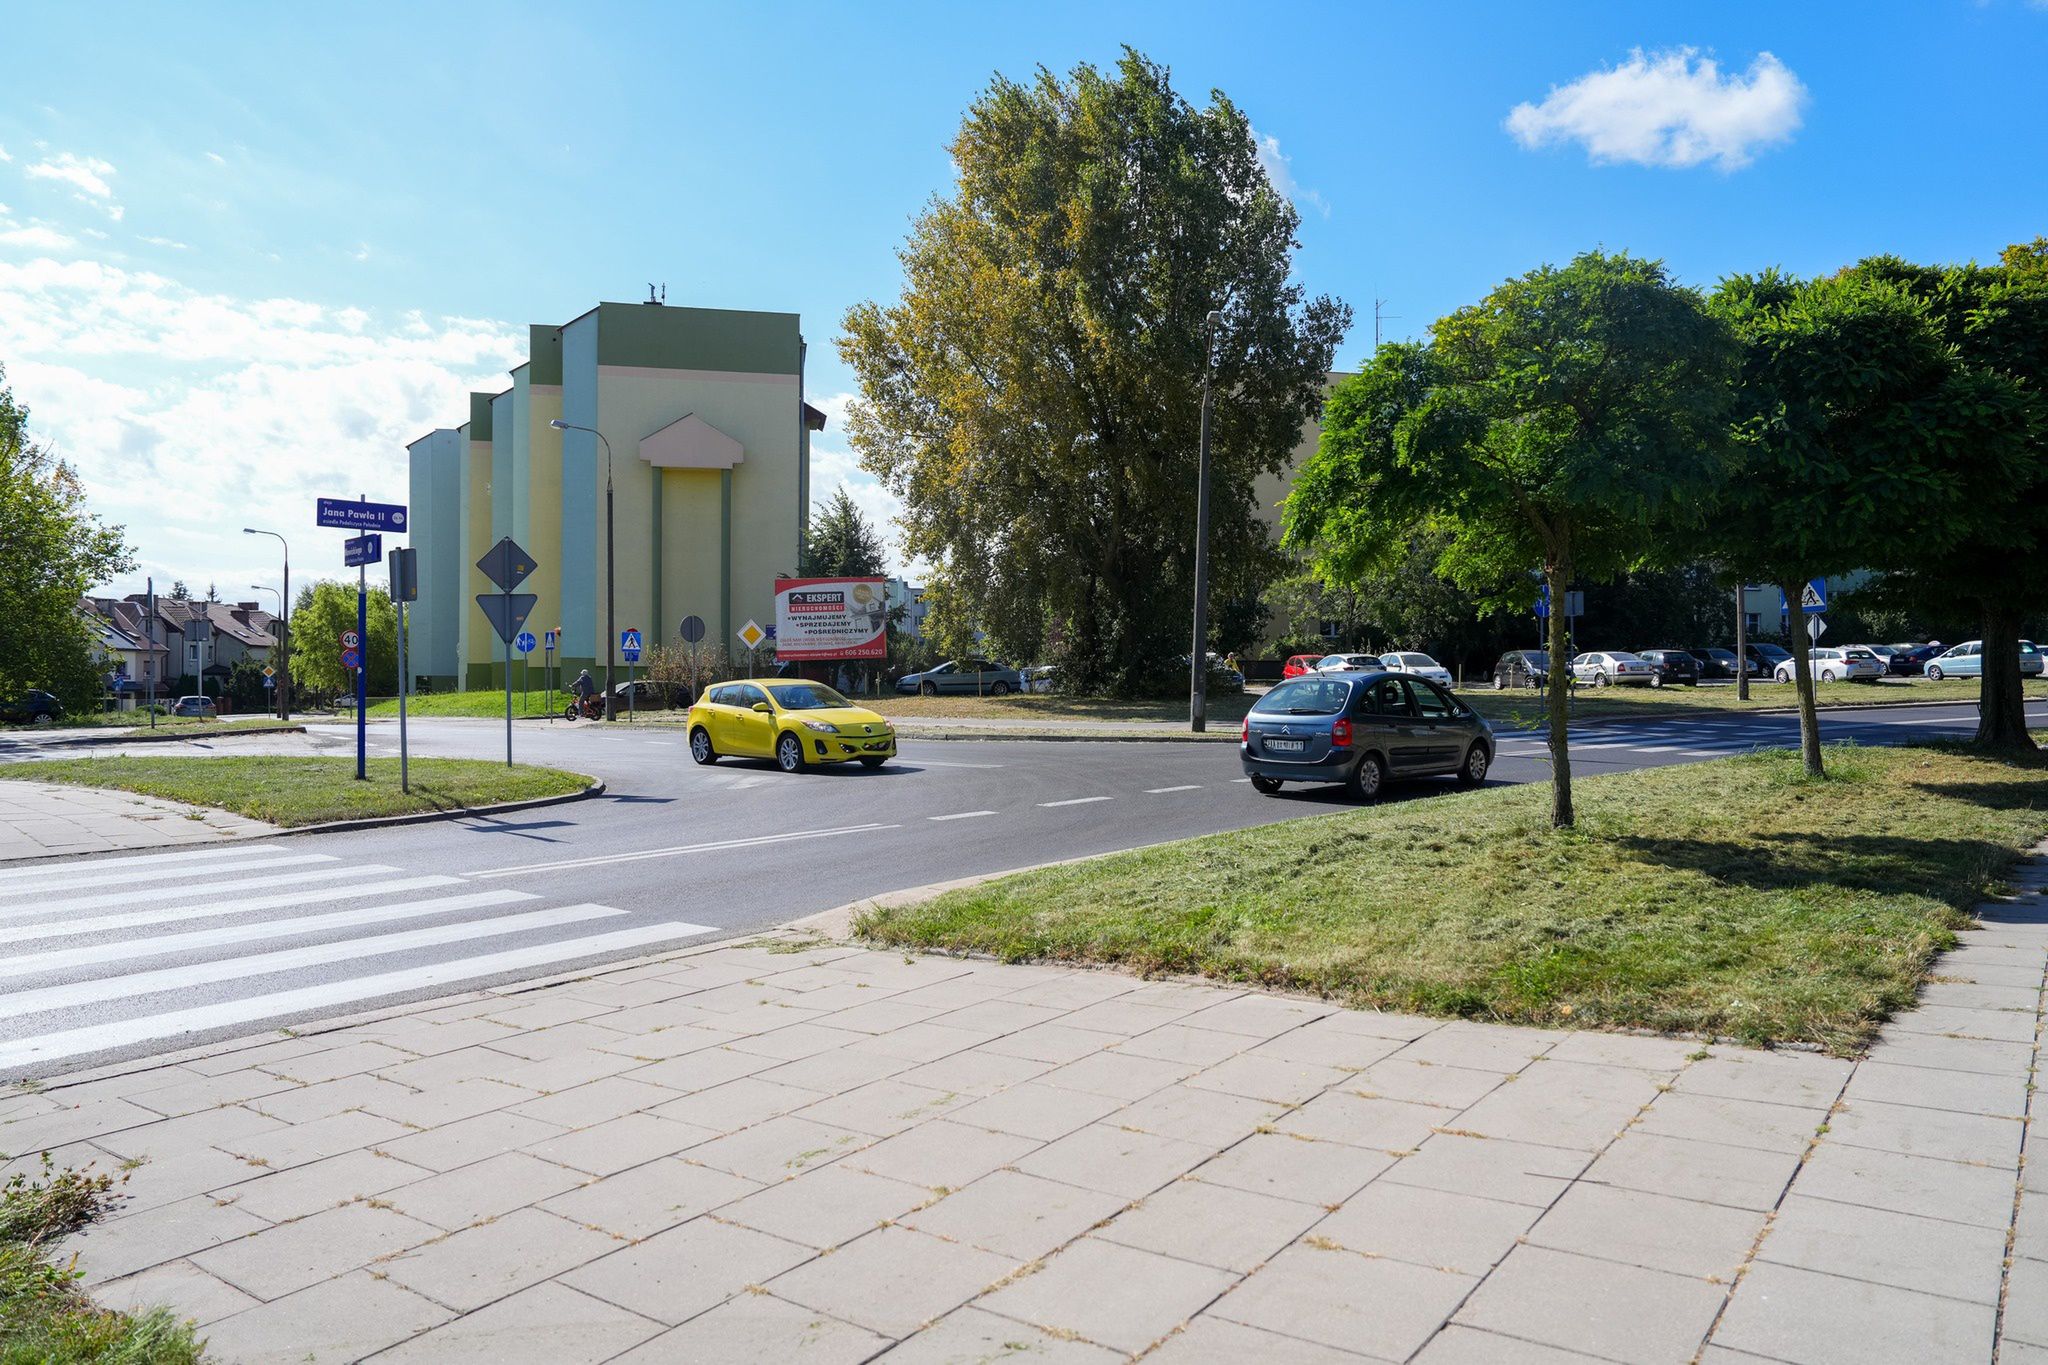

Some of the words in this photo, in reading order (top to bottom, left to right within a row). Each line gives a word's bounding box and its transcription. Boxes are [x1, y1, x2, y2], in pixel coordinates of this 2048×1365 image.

[323, 507, 345, 517] Jana
[348, 510, 375, 520] Pawła
[378, 512, 385, 521] II
[807, 594, 842, 602] EKSPERT
[344, 635, 358, 644] 40
